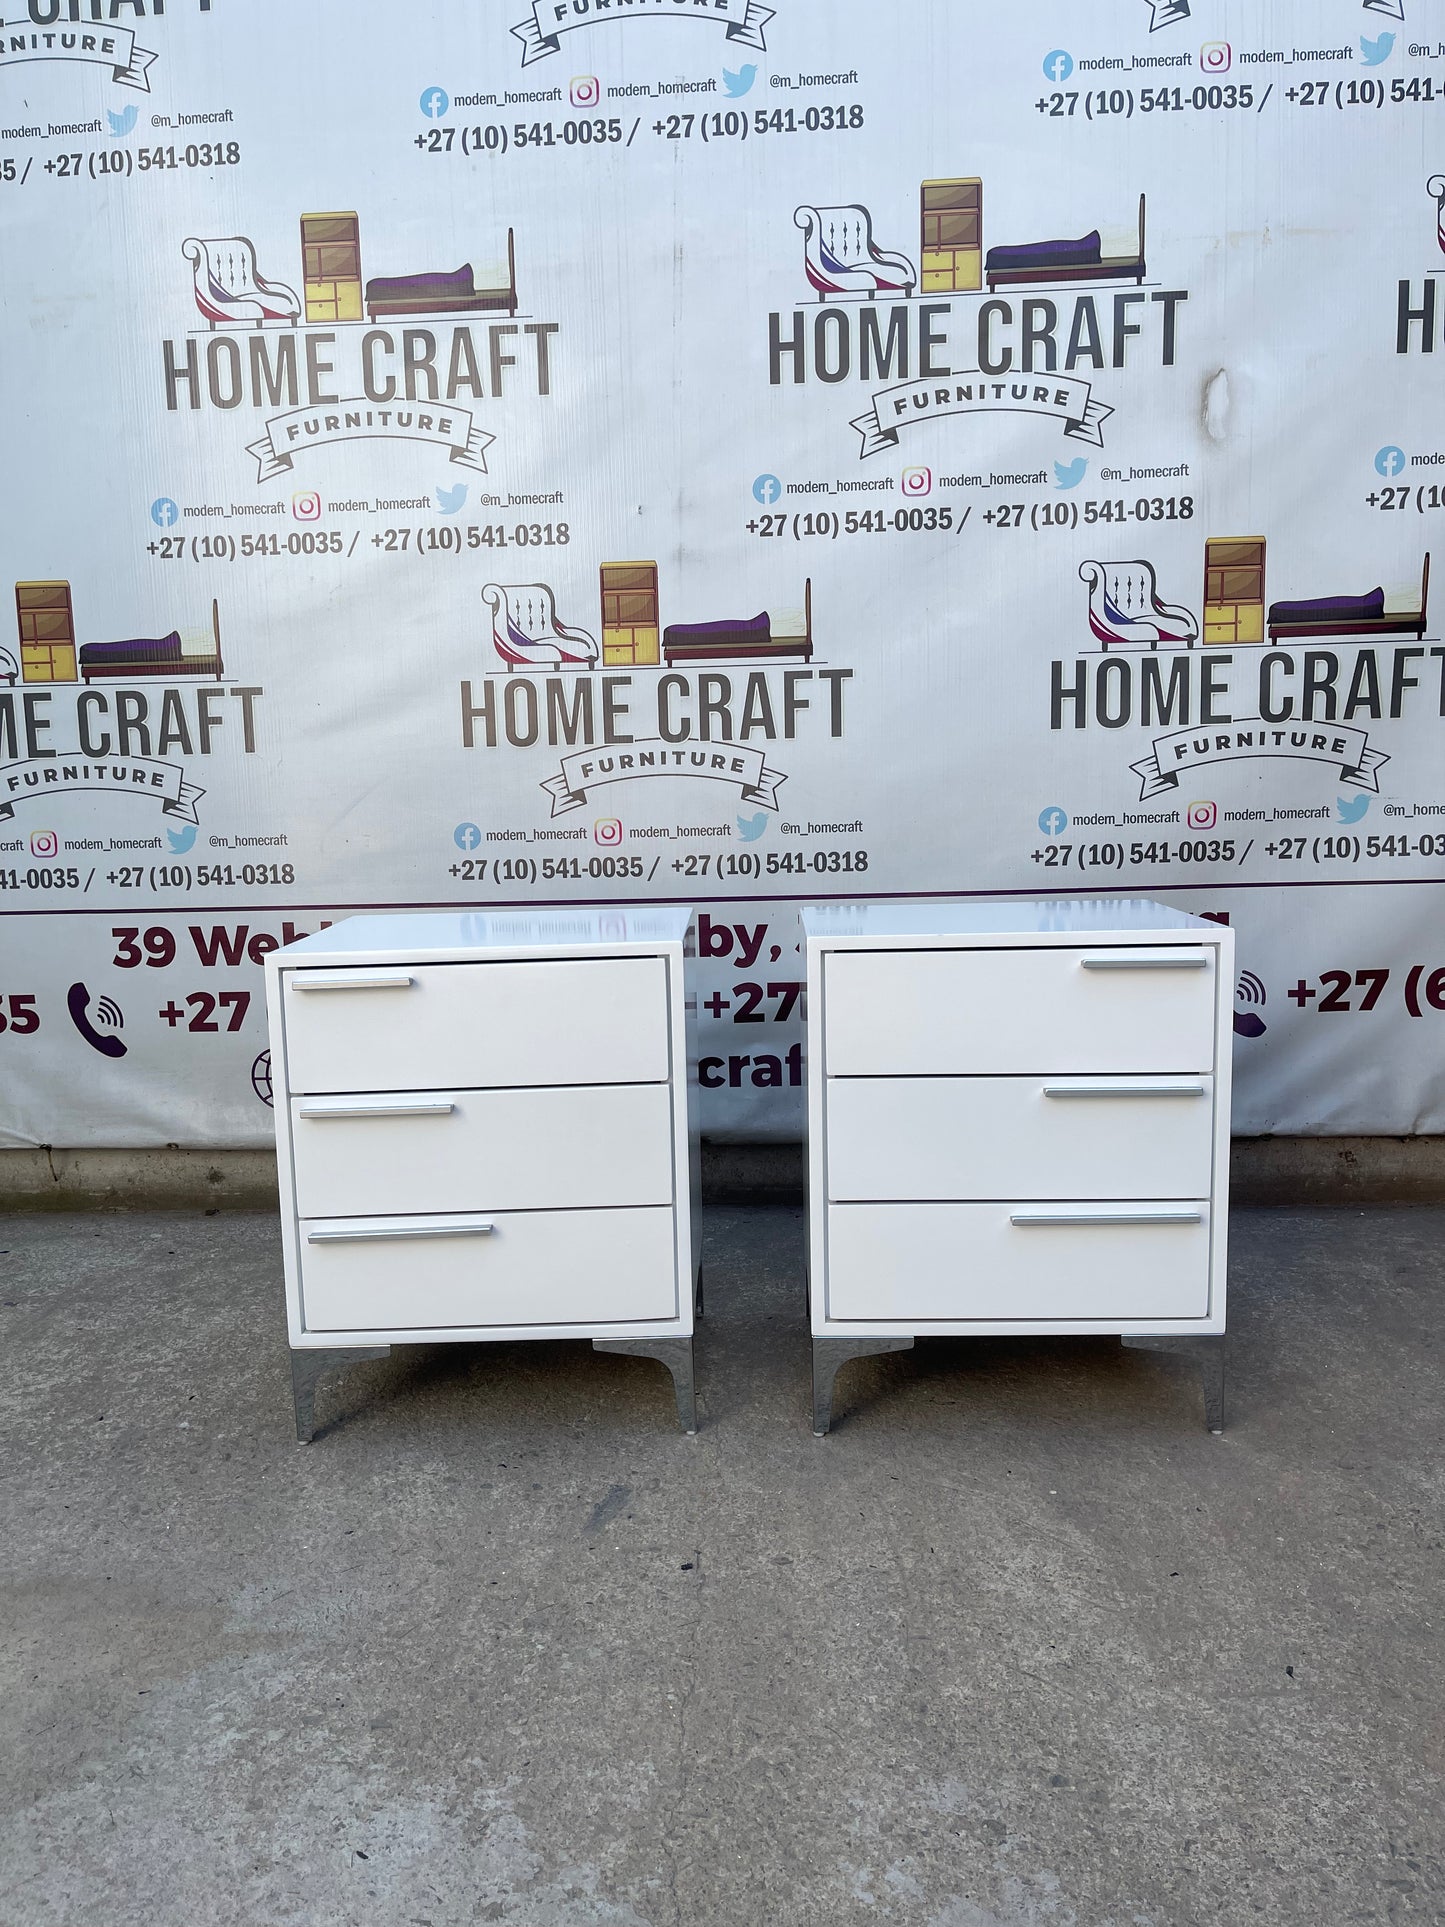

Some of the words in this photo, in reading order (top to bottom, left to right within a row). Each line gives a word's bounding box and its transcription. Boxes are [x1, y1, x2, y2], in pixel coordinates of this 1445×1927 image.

[770, 70, 858, 89] @m_homecraft
[1035, 92, 1079, 116] +27
[1085, 90, 1133, 120] (10)
[1140, 85, 1253, 112] 541-0035
[1285, 82, 1329, 105] +27
[1336, 80, 1384, 109] (10)
[1391, 78, 1445, 102] 541-
[151, 109, 233, 128] @m_homecraft
[414, 128, 455, 152] +27
[462, 125, 507, 156] (10)
[514, 119, 622, 147] 541-0035
[653, 114, 694, 139] +27
[701, 112, 748, 142] (10)
[754, 105, 863, 134] 541-0318
[0, 159, 16, 181] 5
[44, 154, 82, 176] +27
[89, 150, 132, 179] (10)
[138, 142, 240, 170] 541-0318
[769, 303, 951, 387] HOME
[978, 290, 1188, 377] CRAFT
[163, 333, 339, 412] HOME
[362, 323, 559, 405] CRAFT
[892, 381, 1071, 416] FURNITURE
[286, 411, 453, 443] FURNITURE
[1101, 464, 1189, 482] @m_homecraft
[481, 491, 563, 507] @m_homecraft
[1366, 487, 1410, 510] +27
[746, 514, 787, 537] +27
[793, 513, 838, 540] (10)
[845, 507, 952, 533] 541-0035
[983, 505, 1025, 527] +27
[1031, 503, 1078, 531] (10)
[1084, 496, 1193, 523] 541-0318
[147, 537, 185, 558] +27
[192, 535, 235, 563] (10)
[241, 532, 343, 556] 541-0035
[371, 529, 410, 551] +27
[417, 527, 461, 555] (10)
[468, 523, 570, 548] 541-0318
[461, 676, 633, 750] HOME
[658, 669, 853, 745] CRAFT
[1051, 655, 1232, 732] HOME
[77, 687, 263, 760] CRAFT
[1174, 732, 1346, 761] FURNITURE
[7, 766, 164, 792] FURNITURE
[581, 751, 745, 780] FURNITURE
[209, 834, 288, 848] @m_homecraft
[781, 820, 863, 836] @m_homecraft
[449, 860, 487, 880] +27
[494, 859, 536, 884] (10)
[542, 857, 643, 879] 541-0035
[672, 855, 710, 875] +27
[717, 854, 760, 880] (10)
[766, 851, 868, 874] 541-0318
[1031, 845, 1072, 866] +27
[1079, 844, 1124, 870] (10)
[1130, 840, 1235, 864] 541-0035
[1265, 838, 1307, 859] +27
[1313, 837, 1360, 863] (10)
[107, 867, 143, 887] +27
[150, 866, 191, 891] (10)
[197, 864, 294, 886] 541-0318
[112, 927, 176, 968] 39
[703, 981, 800, 1024] +27
[1288, 969, 1389, 1012] +27
[0, 995, 40, 1034] 5
[159, 992, 250, 1032] +27
